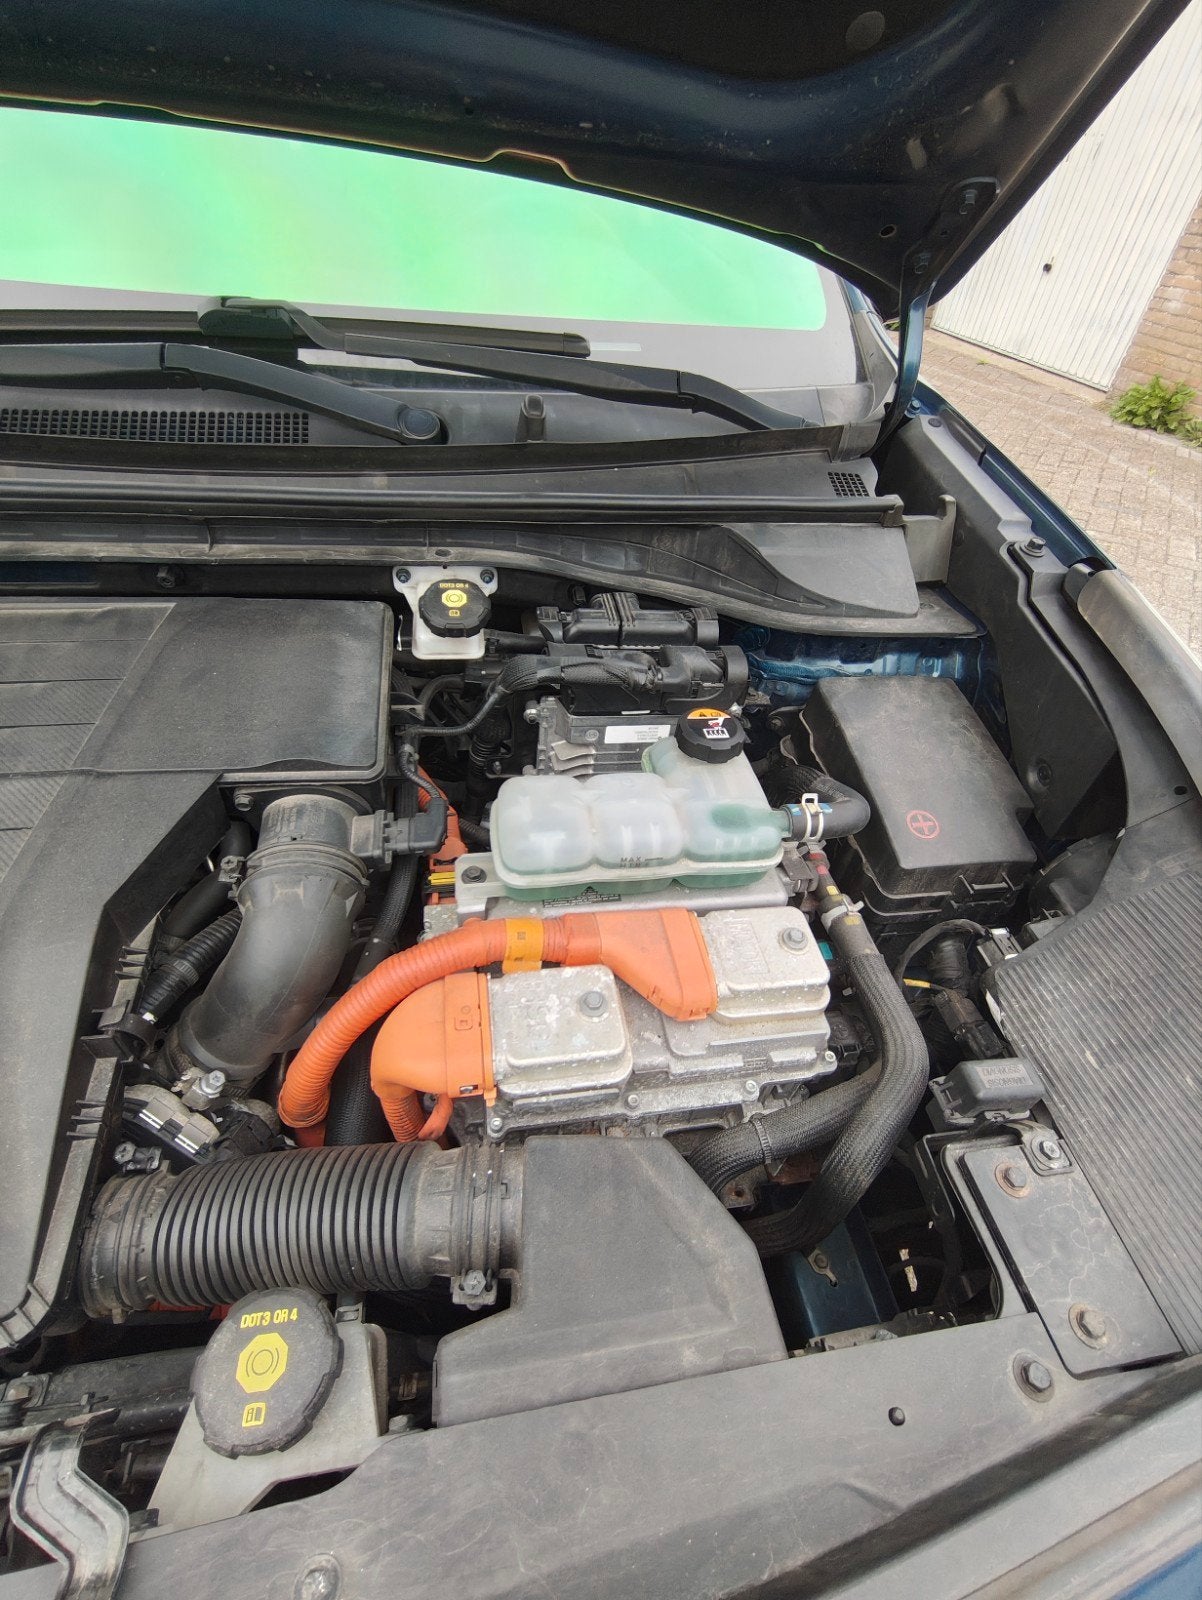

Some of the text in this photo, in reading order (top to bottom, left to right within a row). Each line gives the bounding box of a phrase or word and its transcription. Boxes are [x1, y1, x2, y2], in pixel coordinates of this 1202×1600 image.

[240, 1307, 298, 1329] DOT3 OR 4
